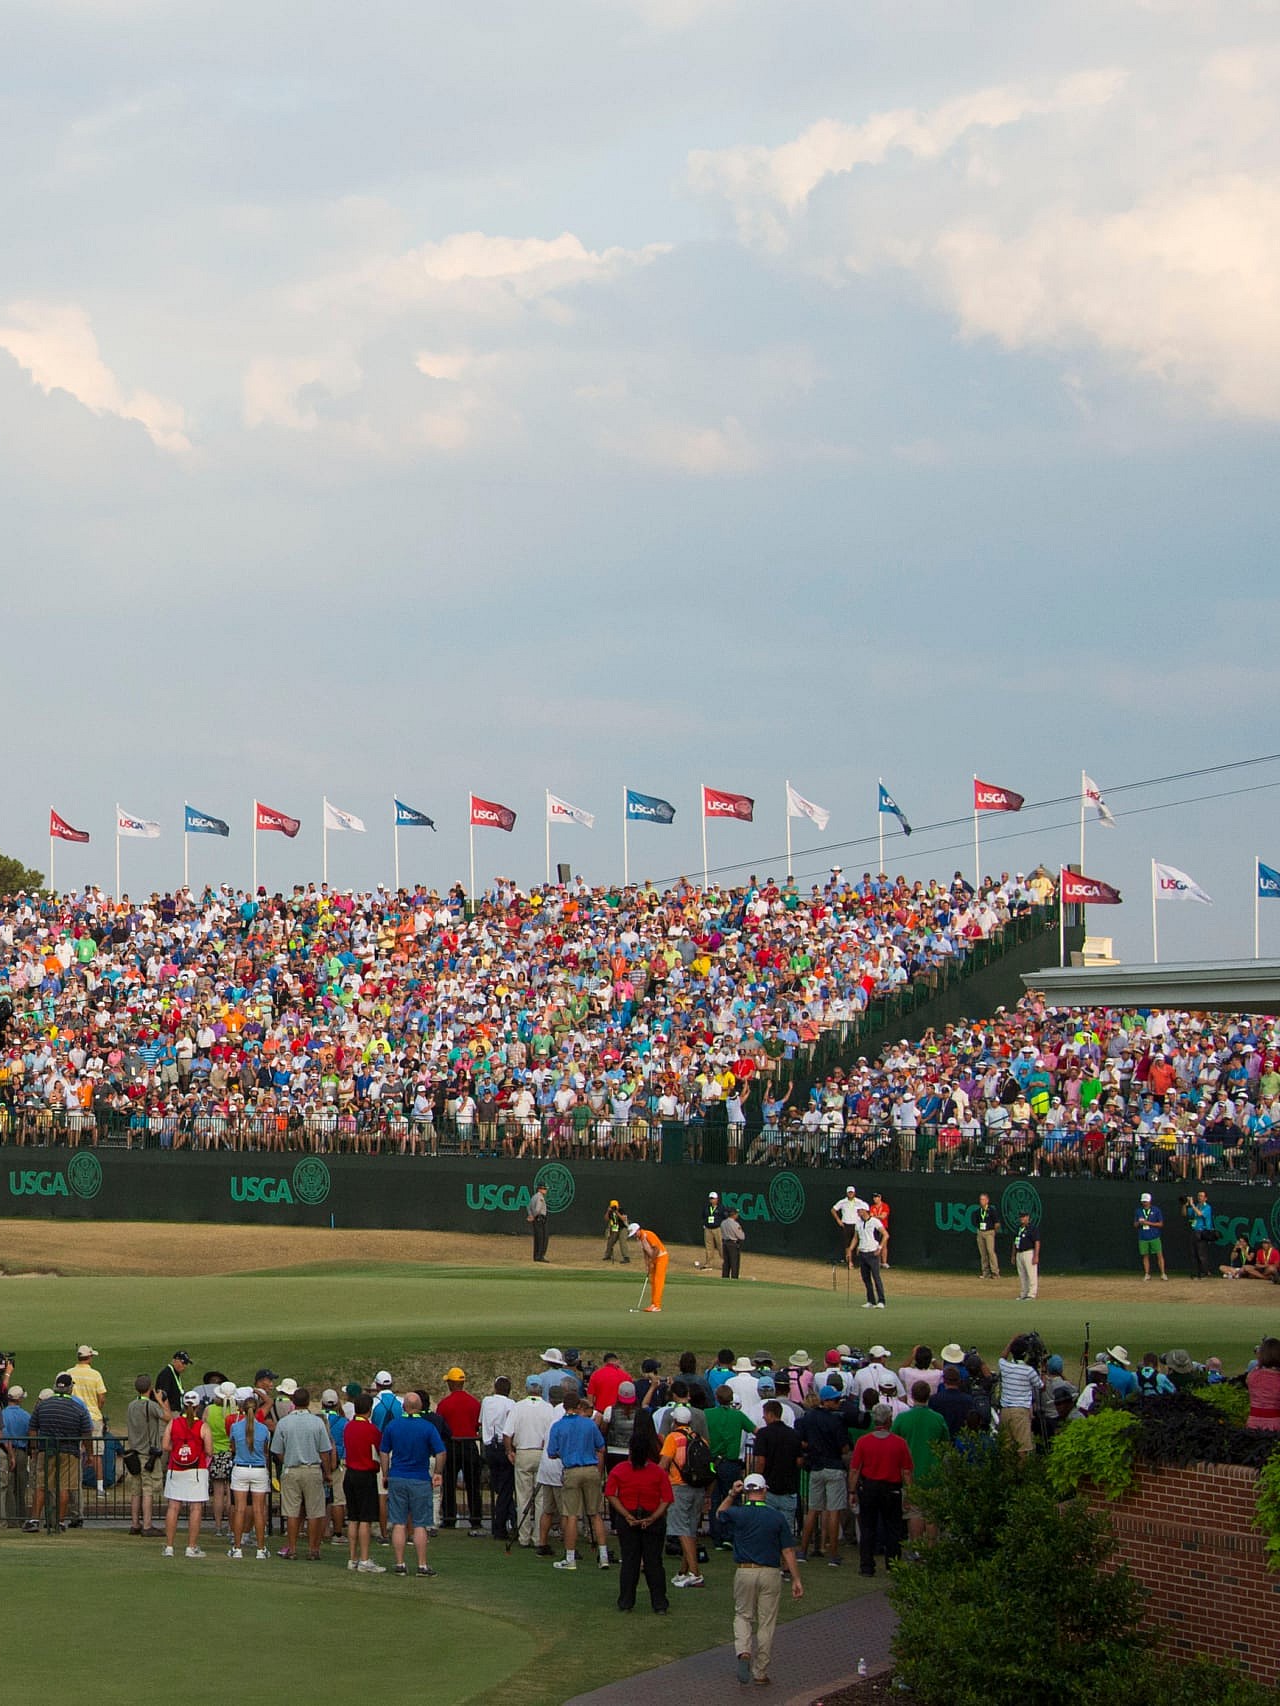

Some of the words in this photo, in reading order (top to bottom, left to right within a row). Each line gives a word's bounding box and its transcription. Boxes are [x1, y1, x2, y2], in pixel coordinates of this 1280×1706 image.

[977, 793, 1007, 804] USGA
[629, 804, 656, 815] USGA
[707, 801, 735, 812] USGA
[473, 809, 500, 821] USGA
[119, 819, 144, 831] USGA
[188, 817, 214, 828] USGA
[1065, 884, 1100, 896] USGA
[10, 1171, 69, 1196] USGA
[231, 1176, 293, 1204] USGA
[467, 1183, 531, 1211] USGA
[1215, 1215, 1271, 1247] SGA
